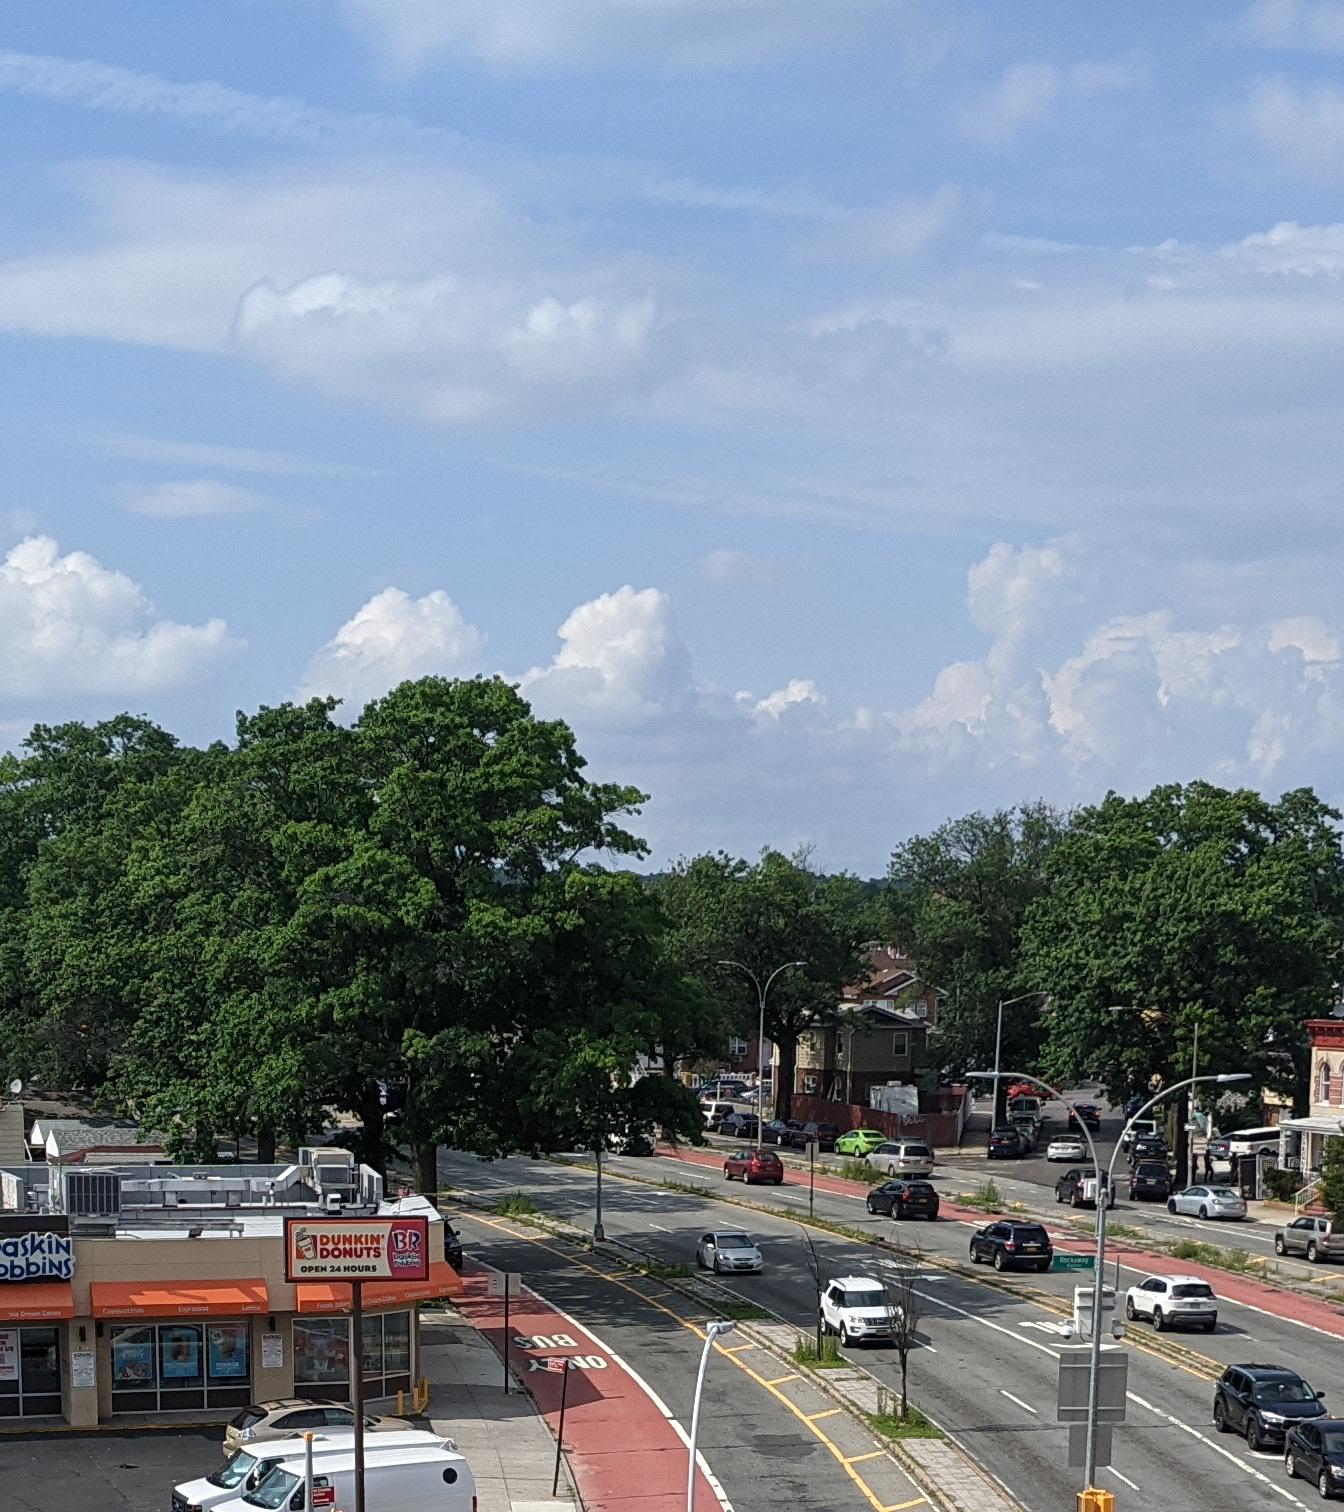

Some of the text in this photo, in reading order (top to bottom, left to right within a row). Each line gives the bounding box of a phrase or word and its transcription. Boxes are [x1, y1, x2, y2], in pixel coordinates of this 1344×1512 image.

[320, 1234, 385, 1246] DUNKIN'
[392, 1230, 421, 1250] BR
[320, 1247, 382, 1259] DONUTS
[300, 1264, 377, 1273] OPEN 24 HOURS
[529, 1355, 608, 1372] ONY
